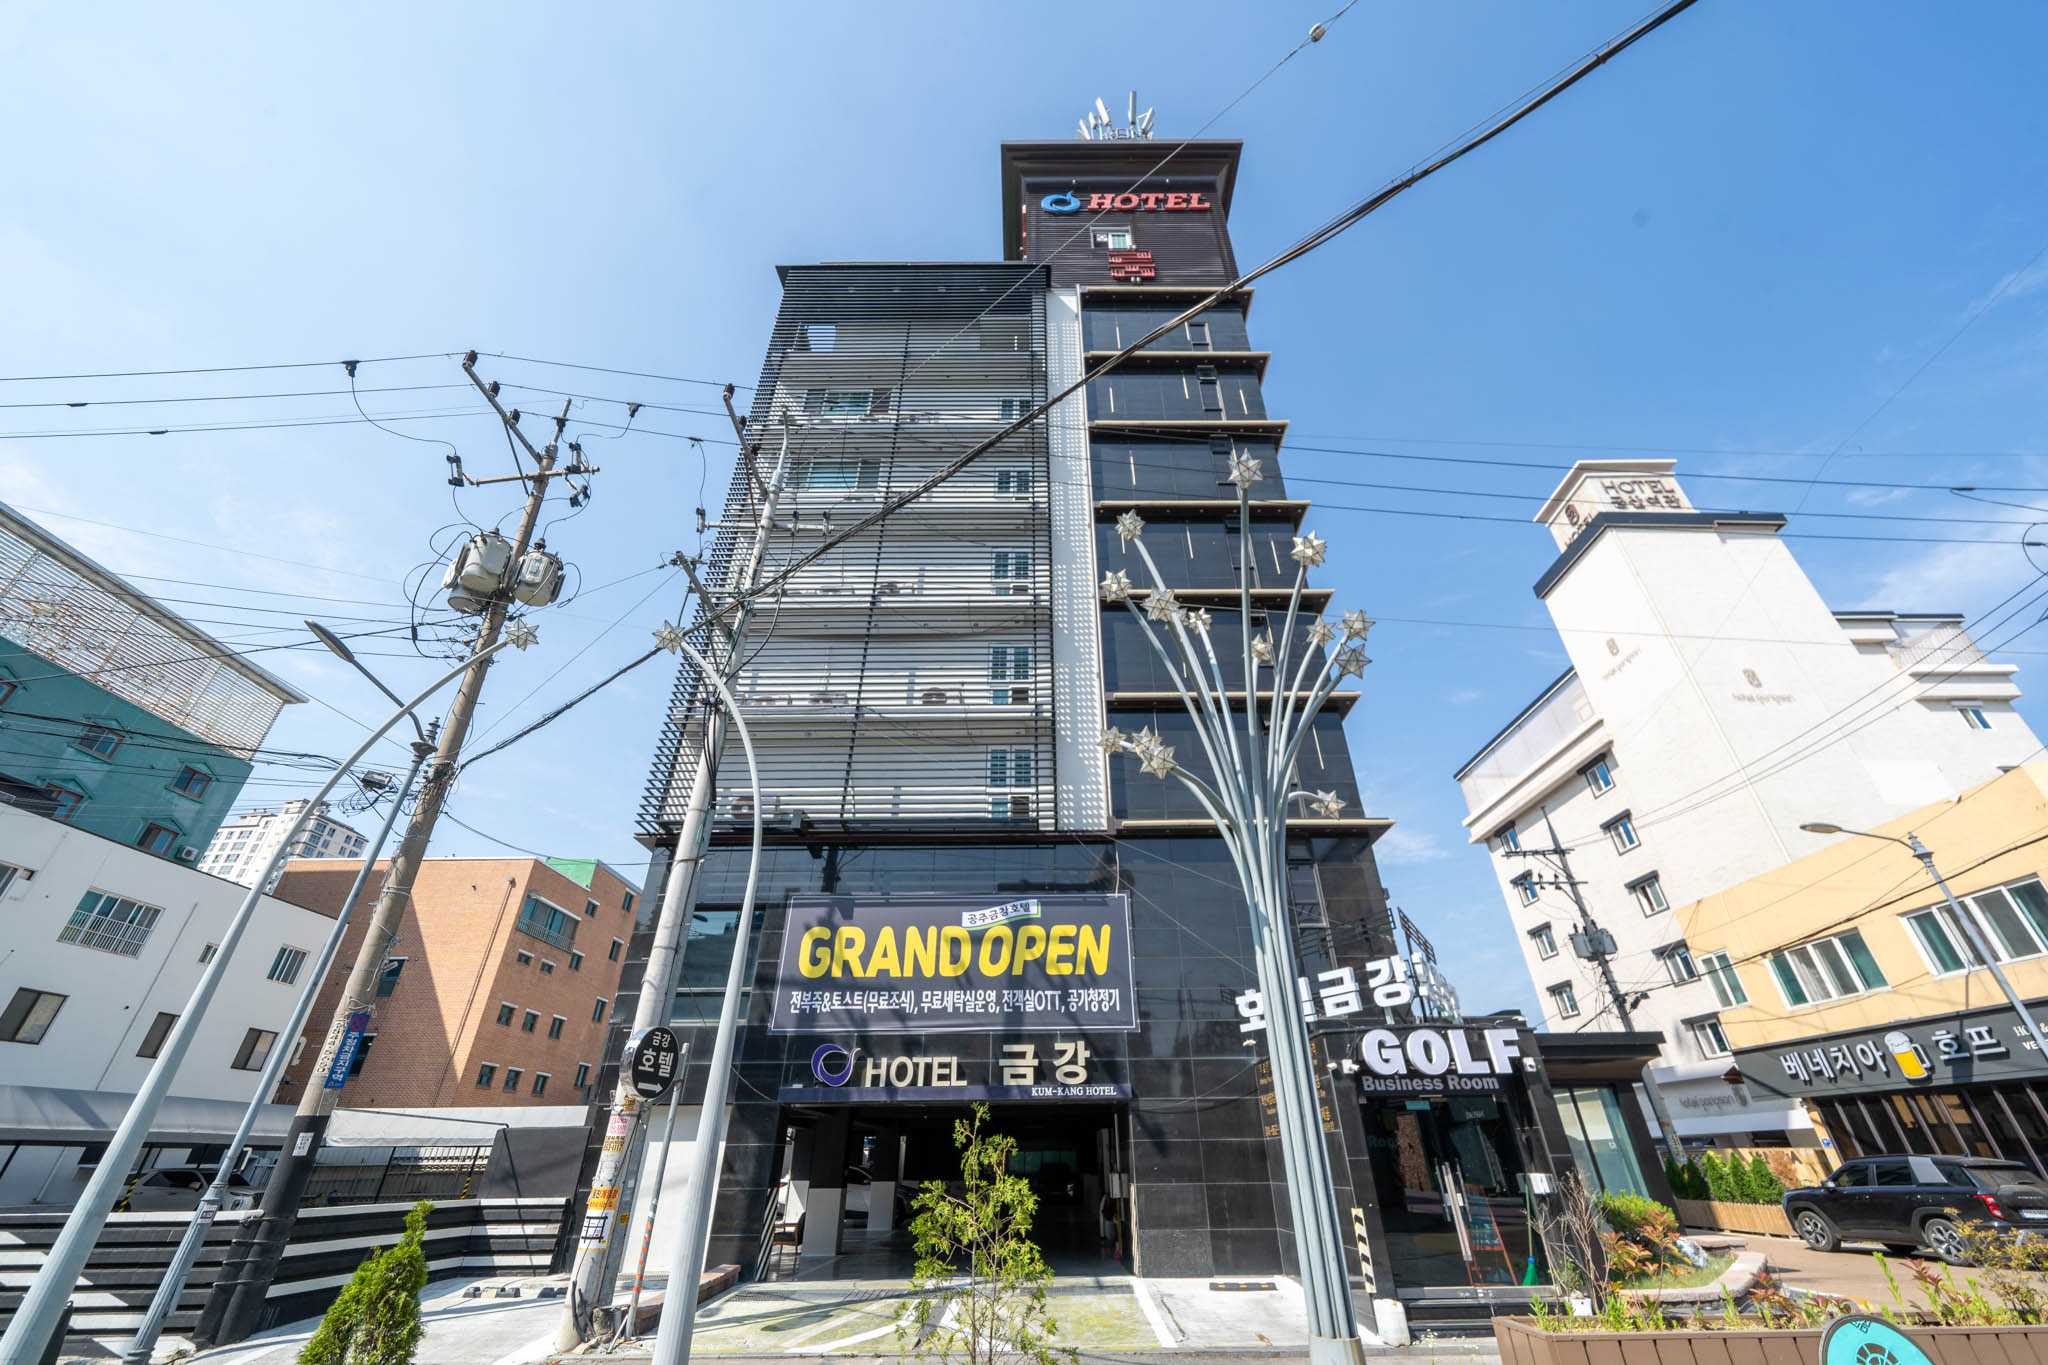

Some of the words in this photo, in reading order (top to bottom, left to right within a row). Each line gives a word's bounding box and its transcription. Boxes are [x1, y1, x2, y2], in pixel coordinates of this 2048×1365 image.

[1088, 193, 1210, 211] HOTEL
[1600, 480, 1675, 494] HOTEL
[967, 902, 1031, 925] 공주금강호텔
[799, 925, 971, 978] GRAND
[979, 924, 1111, 977] OPEN
[790, 990, 918, 1014] 전복죽&토스트(무료조식),
[920, 990, 1000, 1014] 무료세탁실운영,
[1002, 989, 1065, 1013] 전객실OTT,
[1067, 988, 1120, 1012] 공기청정기
[1235, 954, 1412, 1033] 호금강
[652, 1031, 671, 1048] 금강
[1362, 1028, 1521, 1075] GOLF
[638, 1048, 674, 1077] 호텔
[1780, 1040, 1888, 1081] 베네치아
[1932, 1026, 2006, 1056] 호프
[865, 1056, 967, 1088] HOTEL
[1362, 1075, 1444, 1091] Business
[1447, 1074, 1499, 1090] Room
[1031, 1087, 1084, 1096] KUM-KANG
[1086, 1086, 1116, 1096] HOTEL
